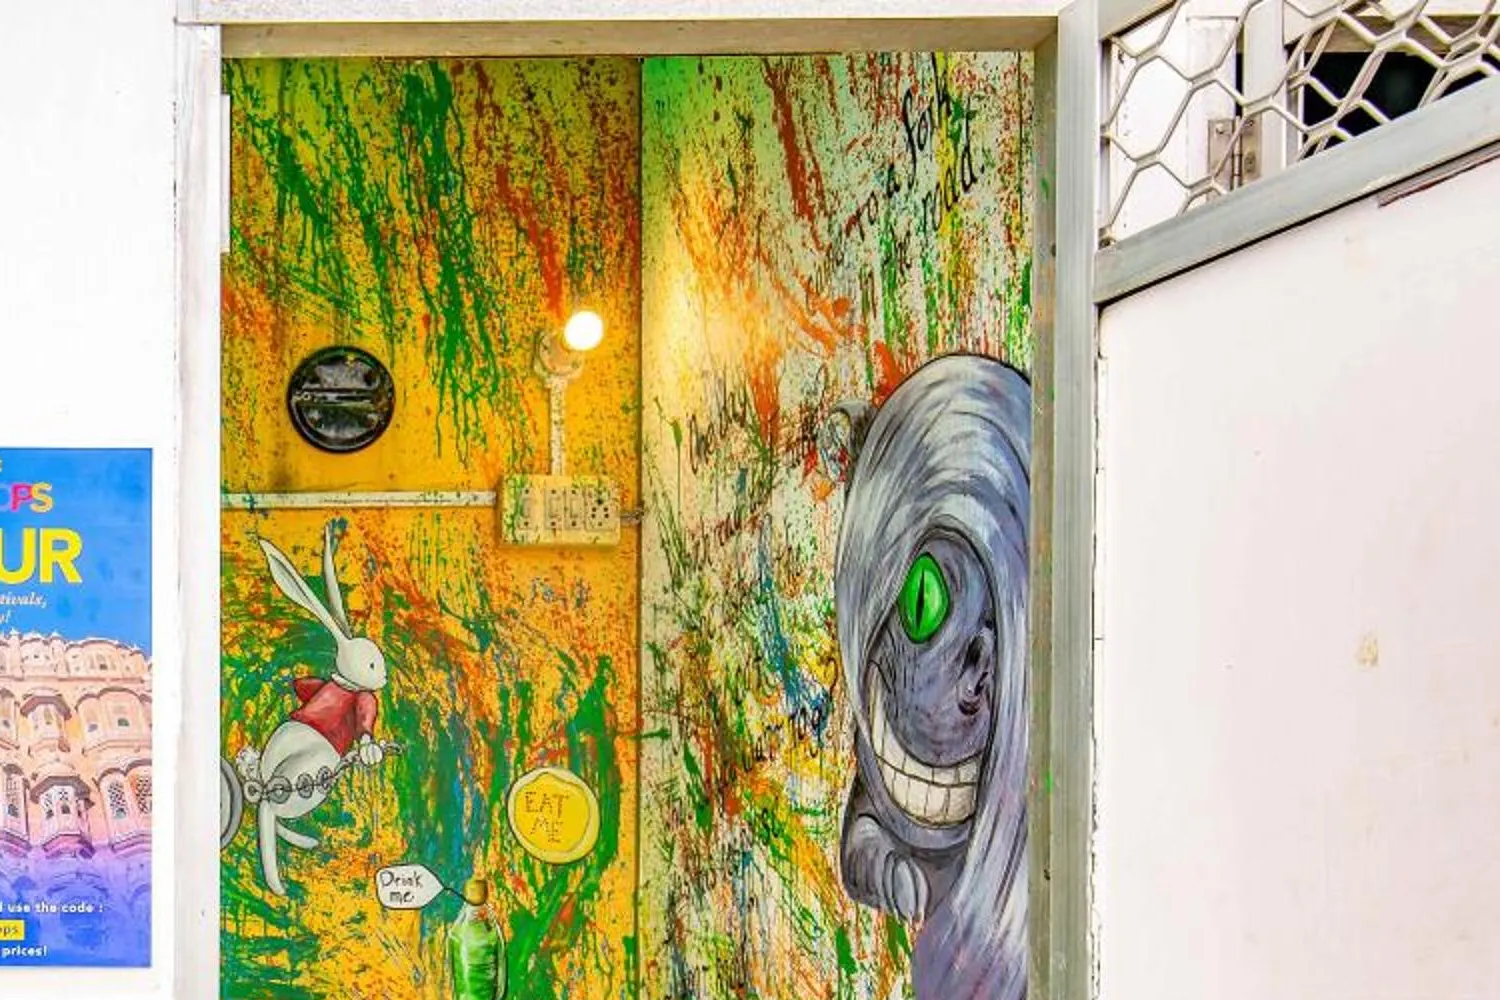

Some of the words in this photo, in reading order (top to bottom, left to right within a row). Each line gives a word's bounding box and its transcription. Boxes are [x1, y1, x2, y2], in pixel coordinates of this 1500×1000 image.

[525, 791, 569, 819] EAT
[380, 870, 423, 888] Drink
[7, 903, 31, 913] use
[35, 901, 57, 912] the
[61, 902, 94, 912] code
